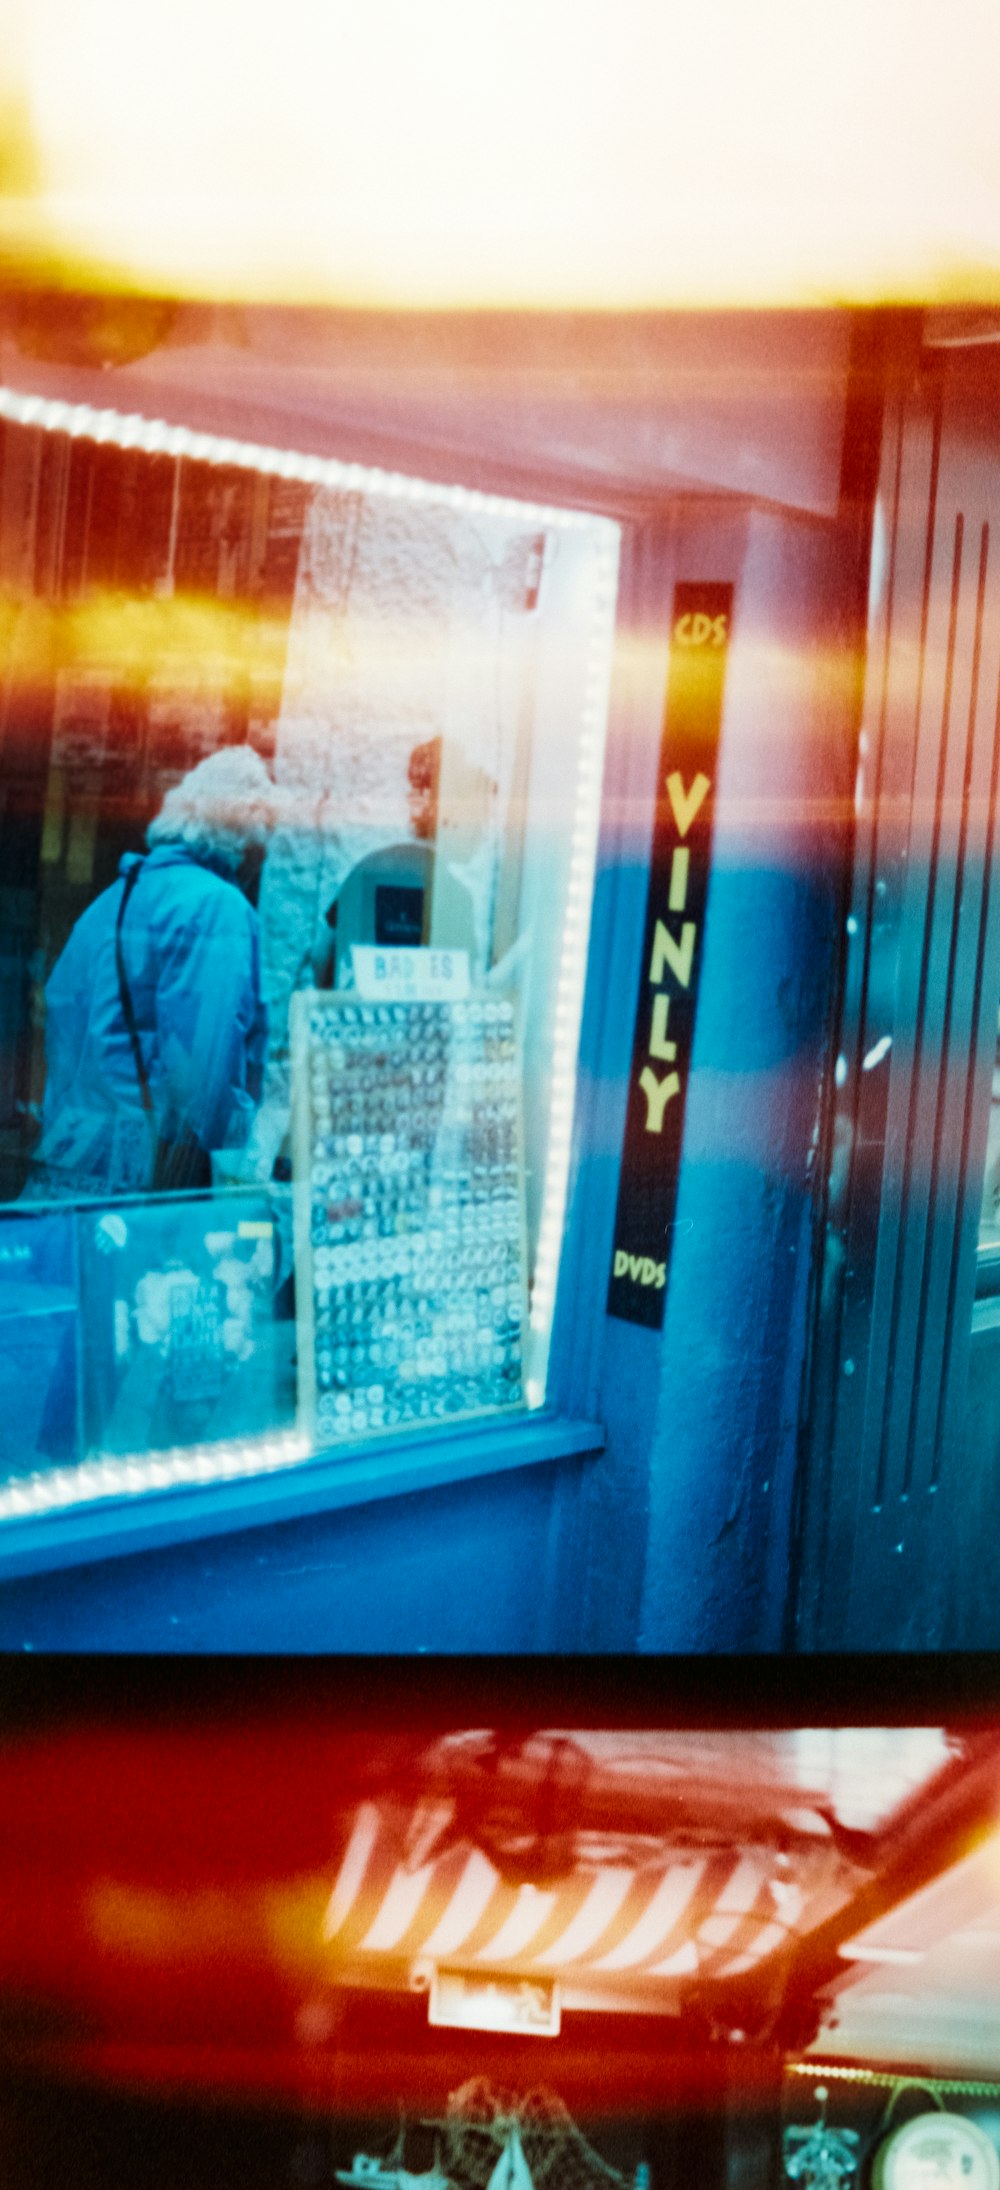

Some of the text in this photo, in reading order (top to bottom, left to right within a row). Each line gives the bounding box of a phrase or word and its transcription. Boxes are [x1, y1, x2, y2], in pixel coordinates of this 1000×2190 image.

[674, 613, 729, 645] CDS
[374, 953, 455, 981] BADES
[637, 772, 711, 1133] VINLY
